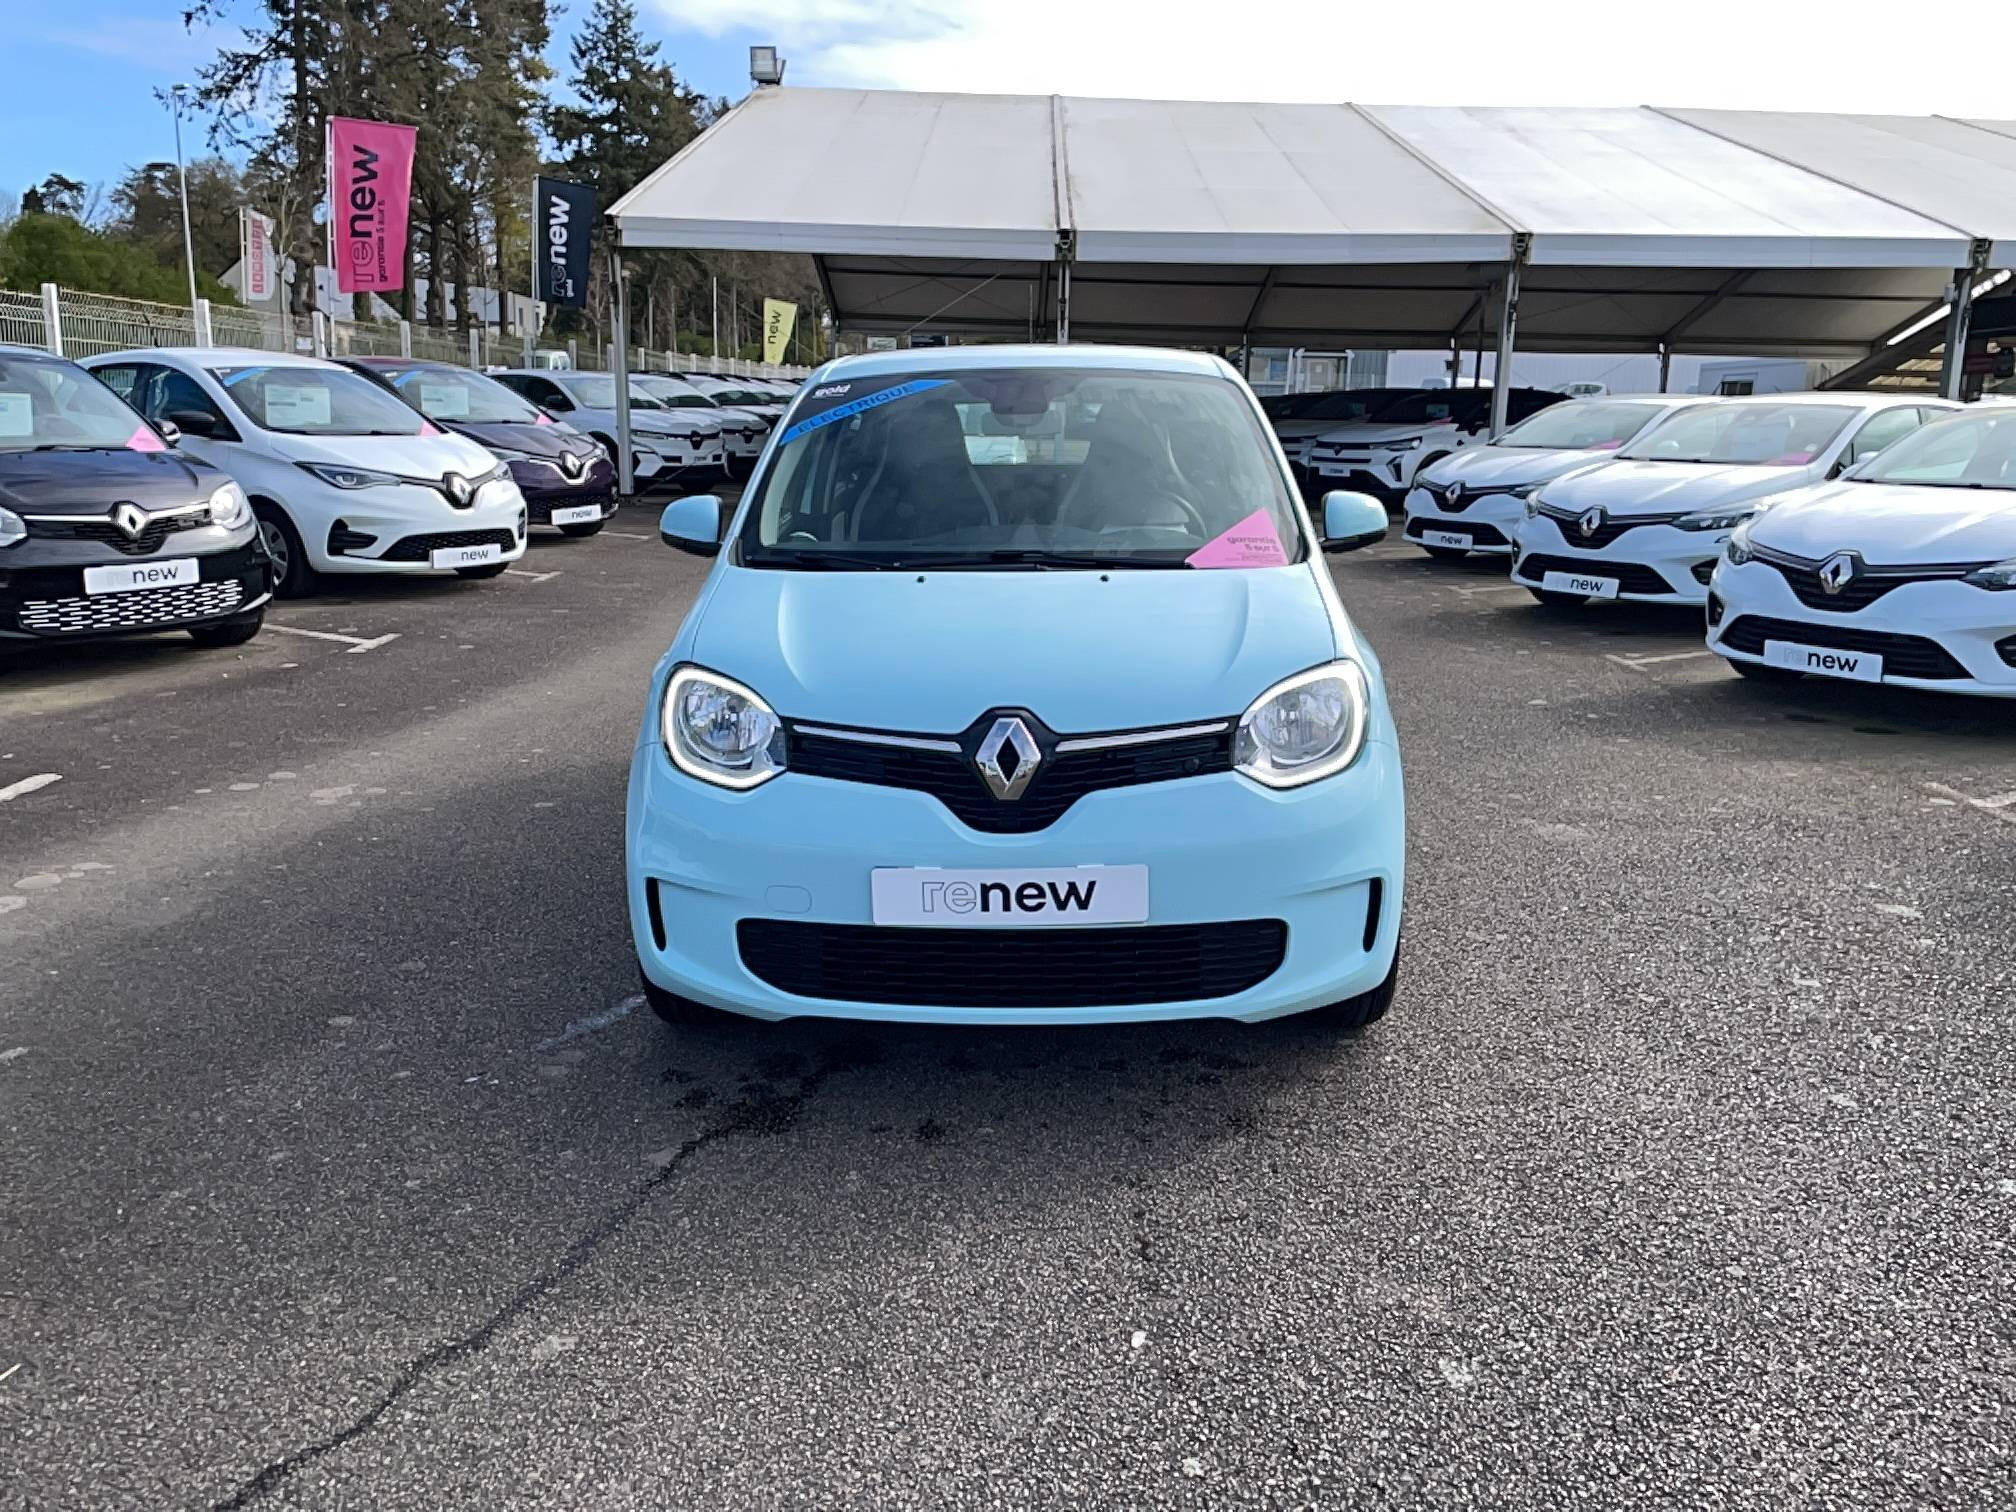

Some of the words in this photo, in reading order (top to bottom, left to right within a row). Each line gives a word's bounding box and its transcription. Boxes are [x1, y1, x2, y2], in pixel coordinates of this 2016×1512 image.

[349, 144, 379, 283] renew
[549, 194, 571, 297] renew
[814, 384, 852, 398] gold
[921, 880, 1097, 914] renew
